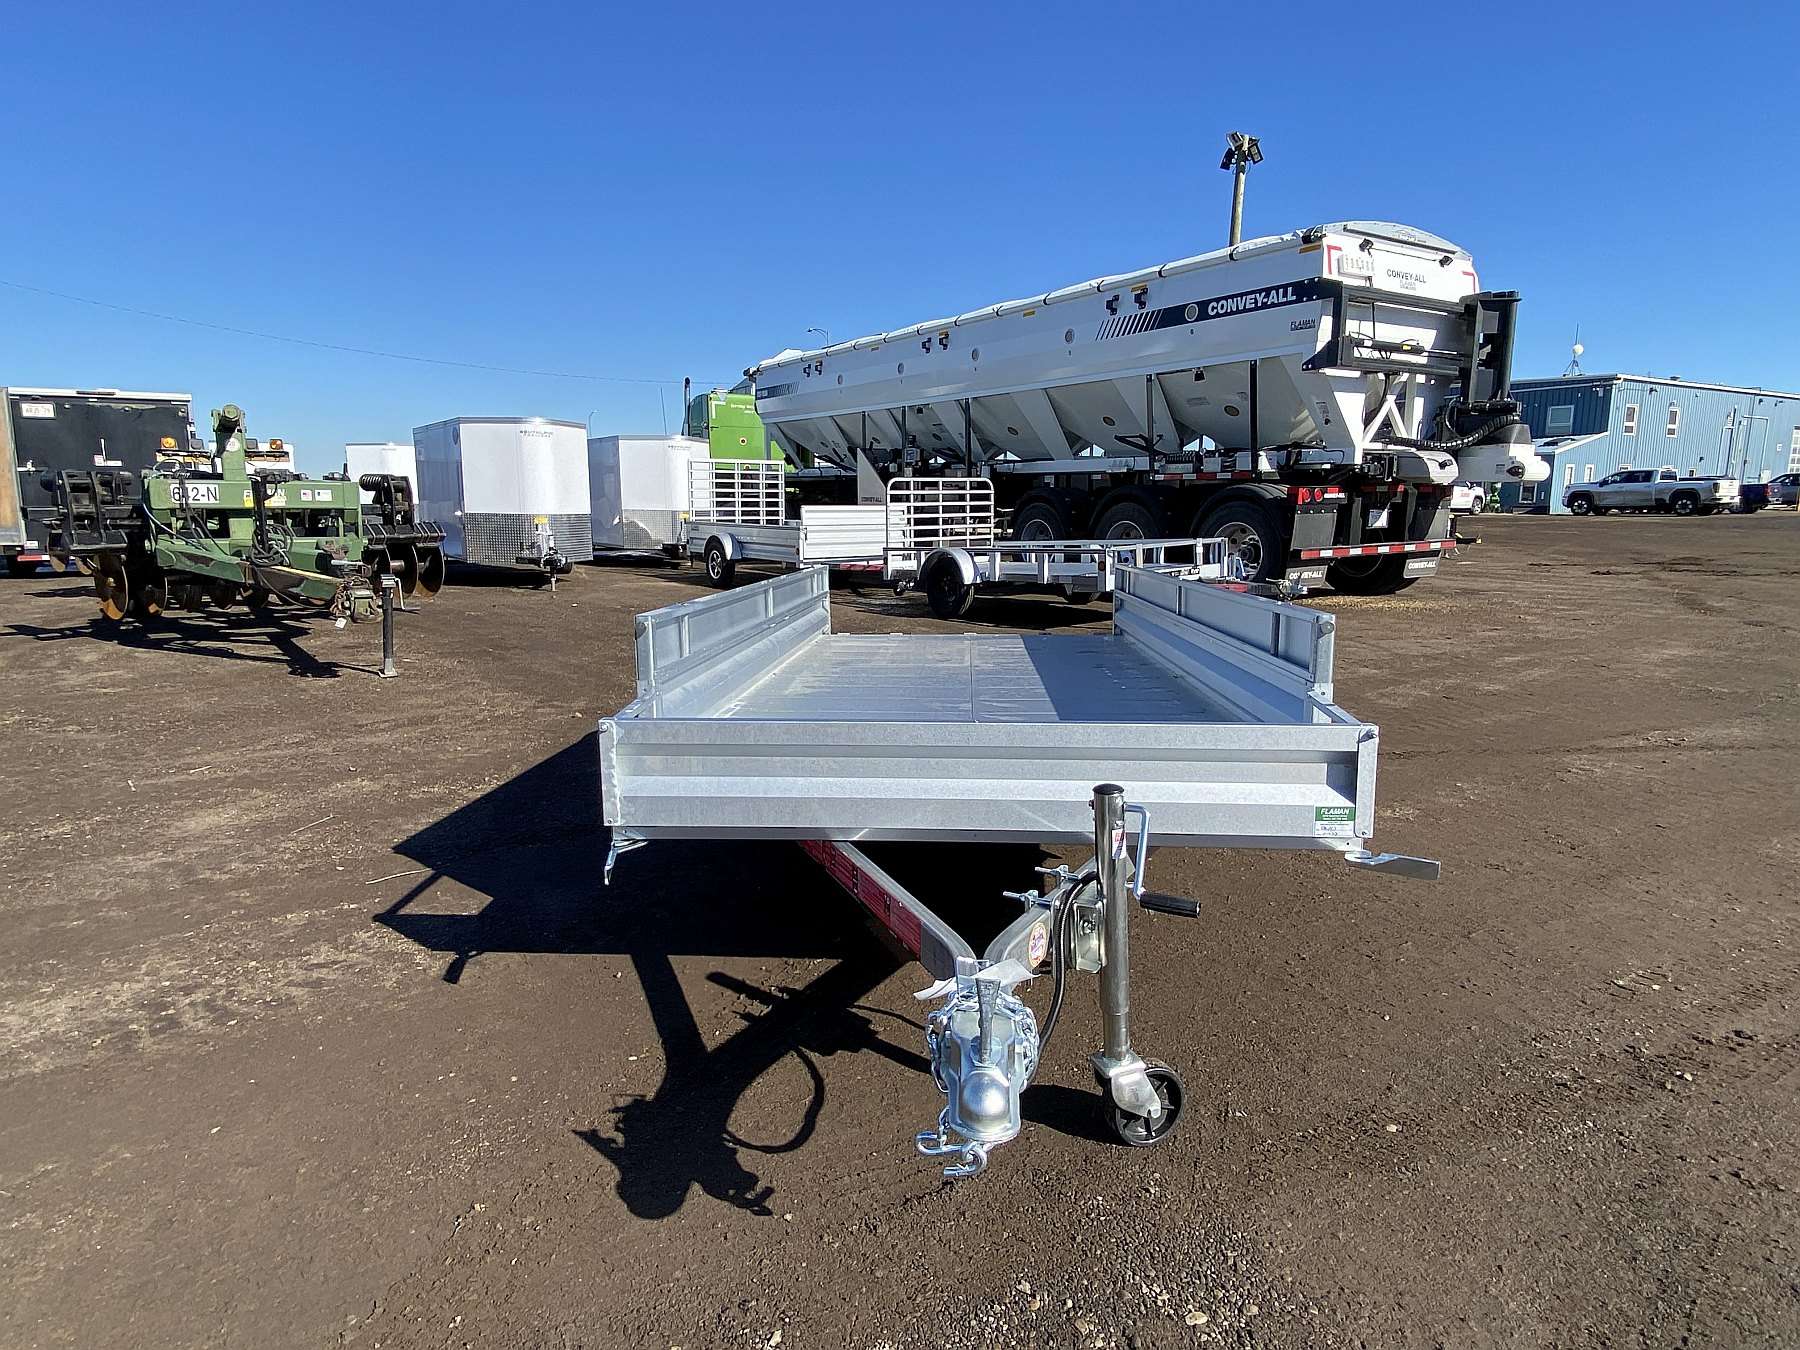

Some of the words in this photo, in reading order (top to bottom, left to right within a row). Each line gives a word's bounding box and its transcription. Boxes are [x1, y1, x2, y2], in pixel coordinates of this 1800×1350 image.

[1387, 269, 1426, 283] CONVEY-ALL
[1207, 286, 1297, 316] CONVEY-ALL
[172, 486, 218, 502] 62-N
